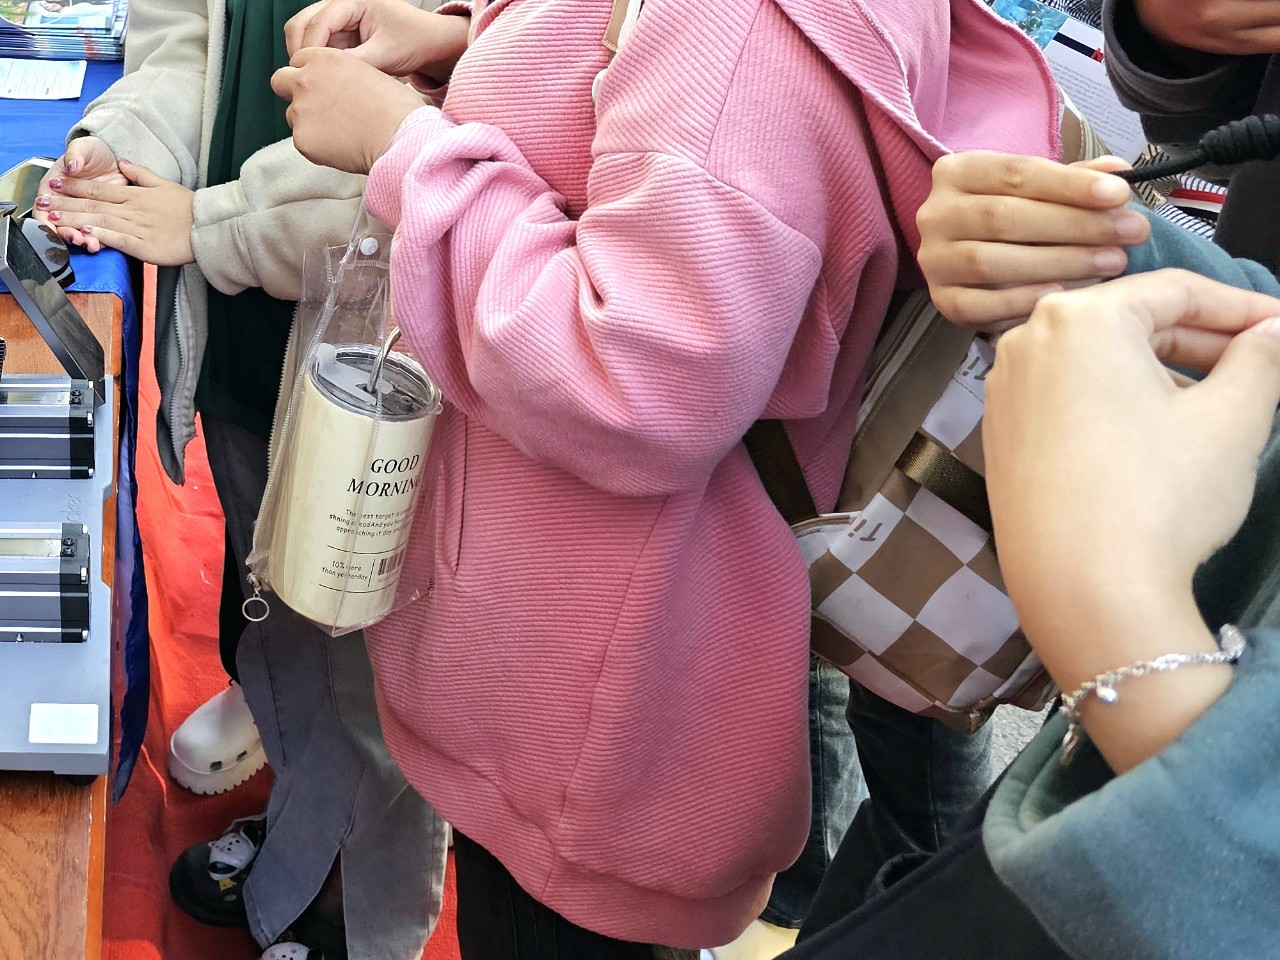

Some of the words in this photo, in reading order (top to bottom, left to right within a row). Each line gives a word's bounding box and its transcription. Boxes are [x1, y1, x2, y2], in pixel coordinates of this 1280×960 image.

[370, 454, 420, 474] GOOD
[346, 509, 357, 517] The
[336, 526, 375, 538] approching
[332, 560, 345, 569] 10%
[322, 567, 336, 576] than
